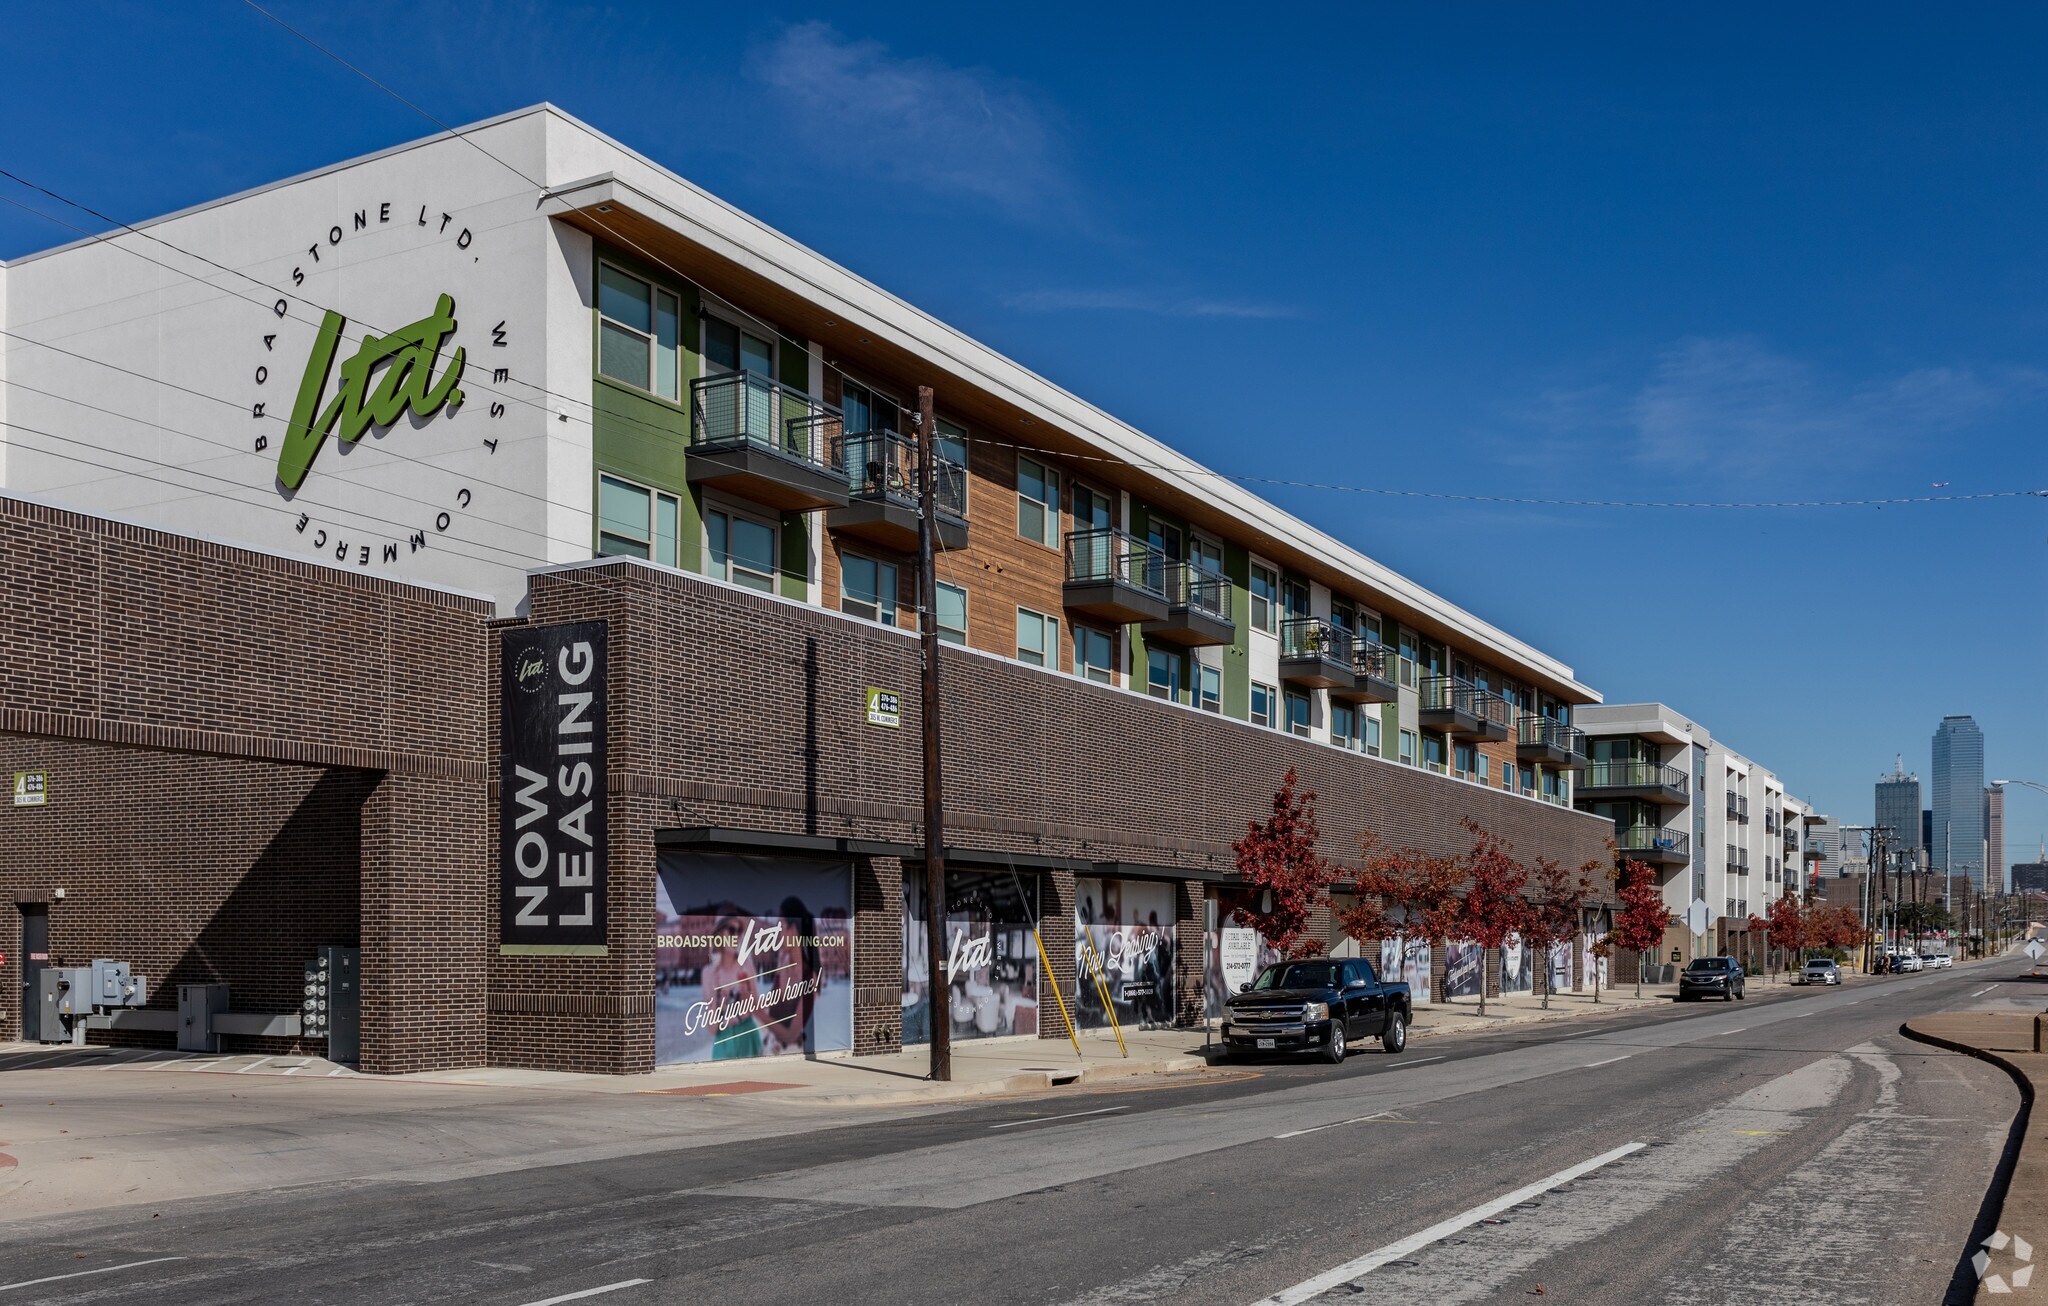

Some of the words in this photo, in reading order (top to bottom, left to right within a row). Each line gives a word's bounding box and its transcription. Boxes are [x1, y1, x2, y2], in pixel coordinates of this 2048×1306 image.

[254, 202, 391, 453] BROADSTONE
[483, 320, 509, 455] WEST
[294, 487, 472, 566] COMMERCE
[870, 694, 879, 713] 4
[16, 776, 26, 795] 4
[558, 640, 594, 927] LEASING
[514, 764, 549, 927] NOW
[656, 935, 738, 948] BROADSTONE
[786, 935, 844, 948] LIVING.COM
[684, 997, 724, 1036] Find
[718, 995, 756, 1031] your
[756, 988, 782, 1010] new
[782, 967, 823, 1003] home!
